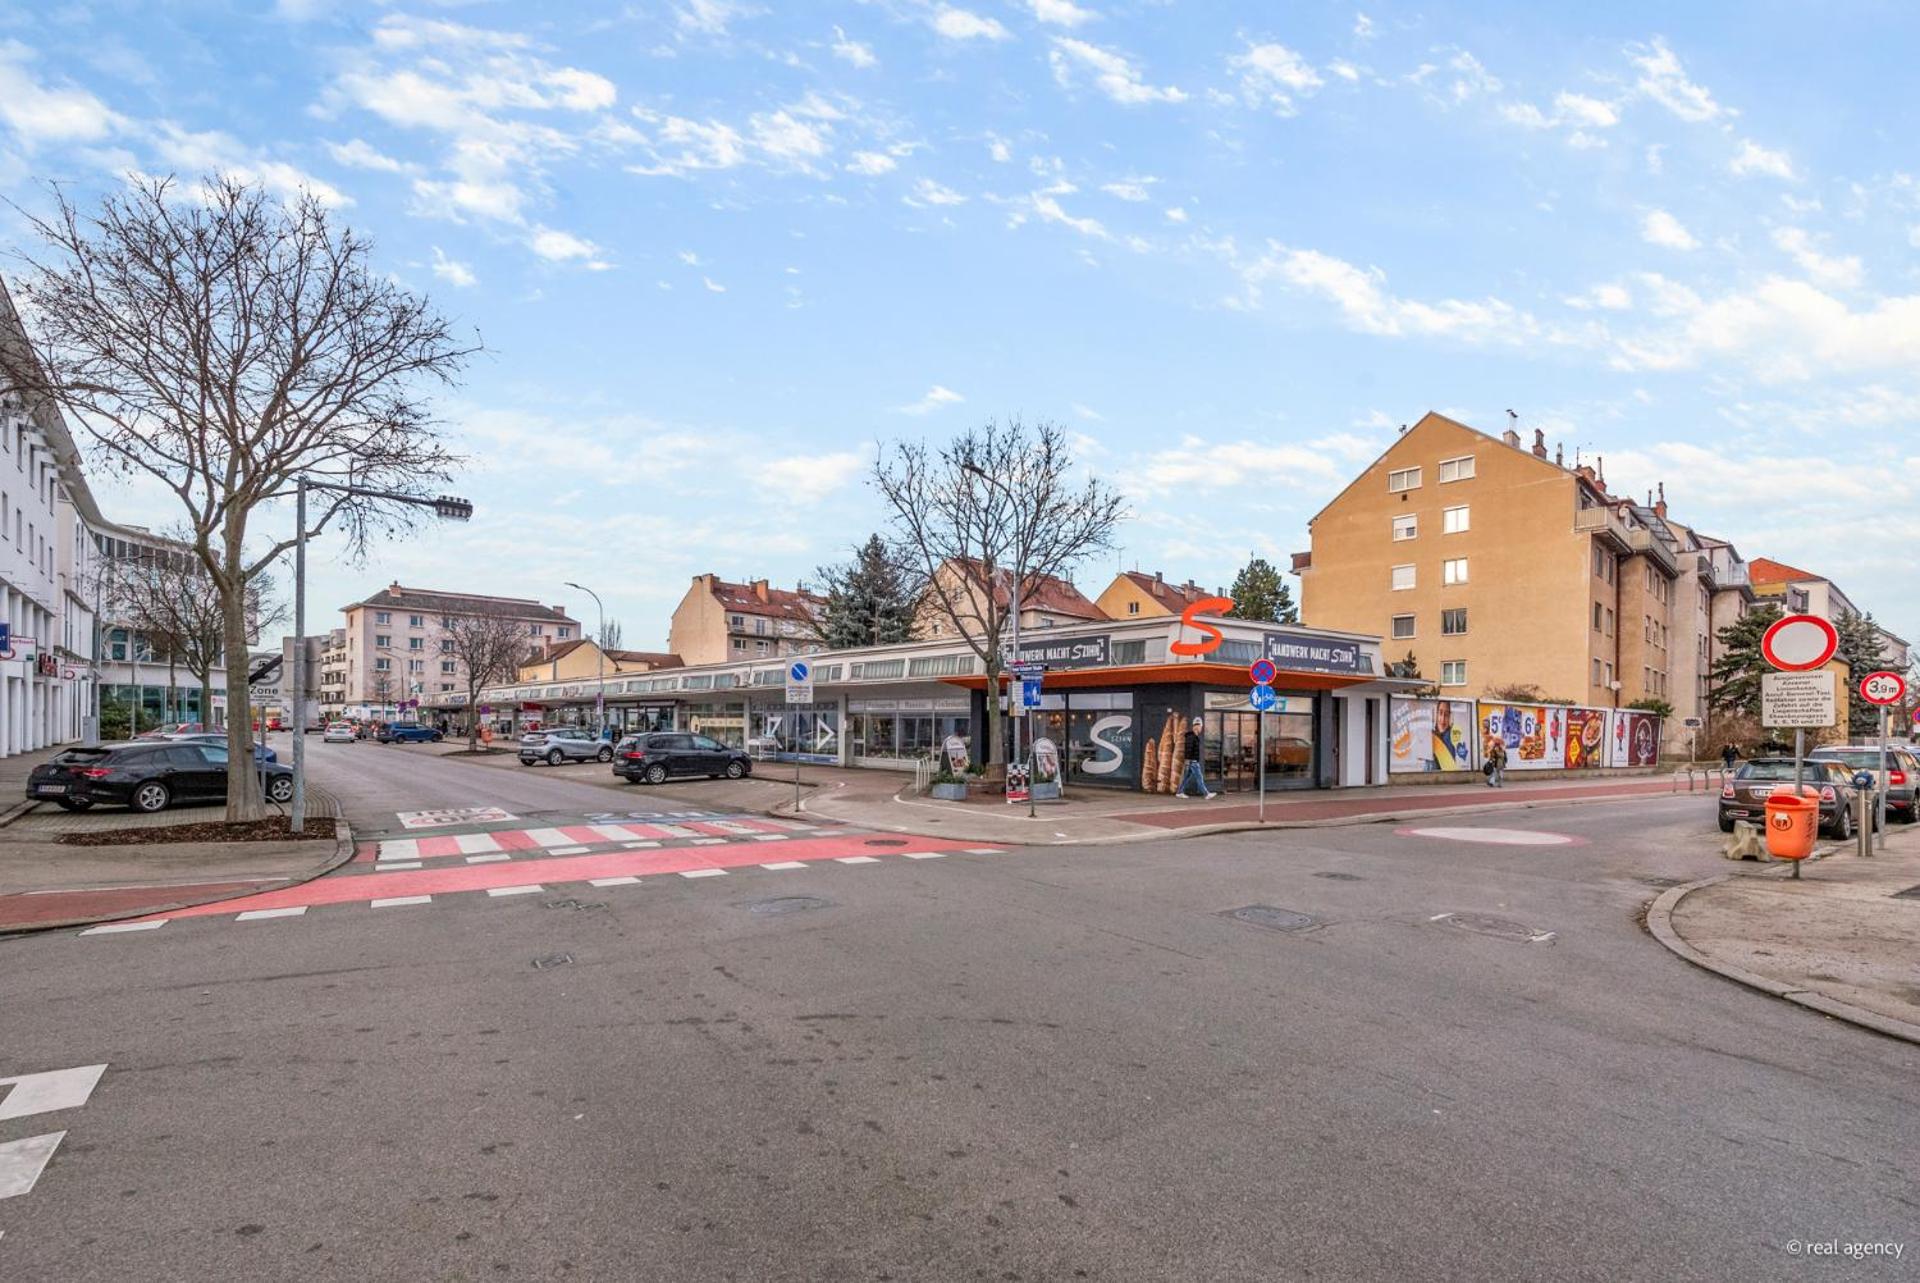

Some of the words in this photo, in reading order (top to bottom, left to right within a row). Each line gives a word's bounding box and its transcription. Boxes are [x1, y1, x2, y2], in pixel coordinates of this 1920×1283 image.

[1046, 646, 1071, 660] MACHT
[1271, 643, 1309, 659] HANDWERK
[1310, 646, 1330, 661] MACHT
[249, 686, 279, 694] Zone
